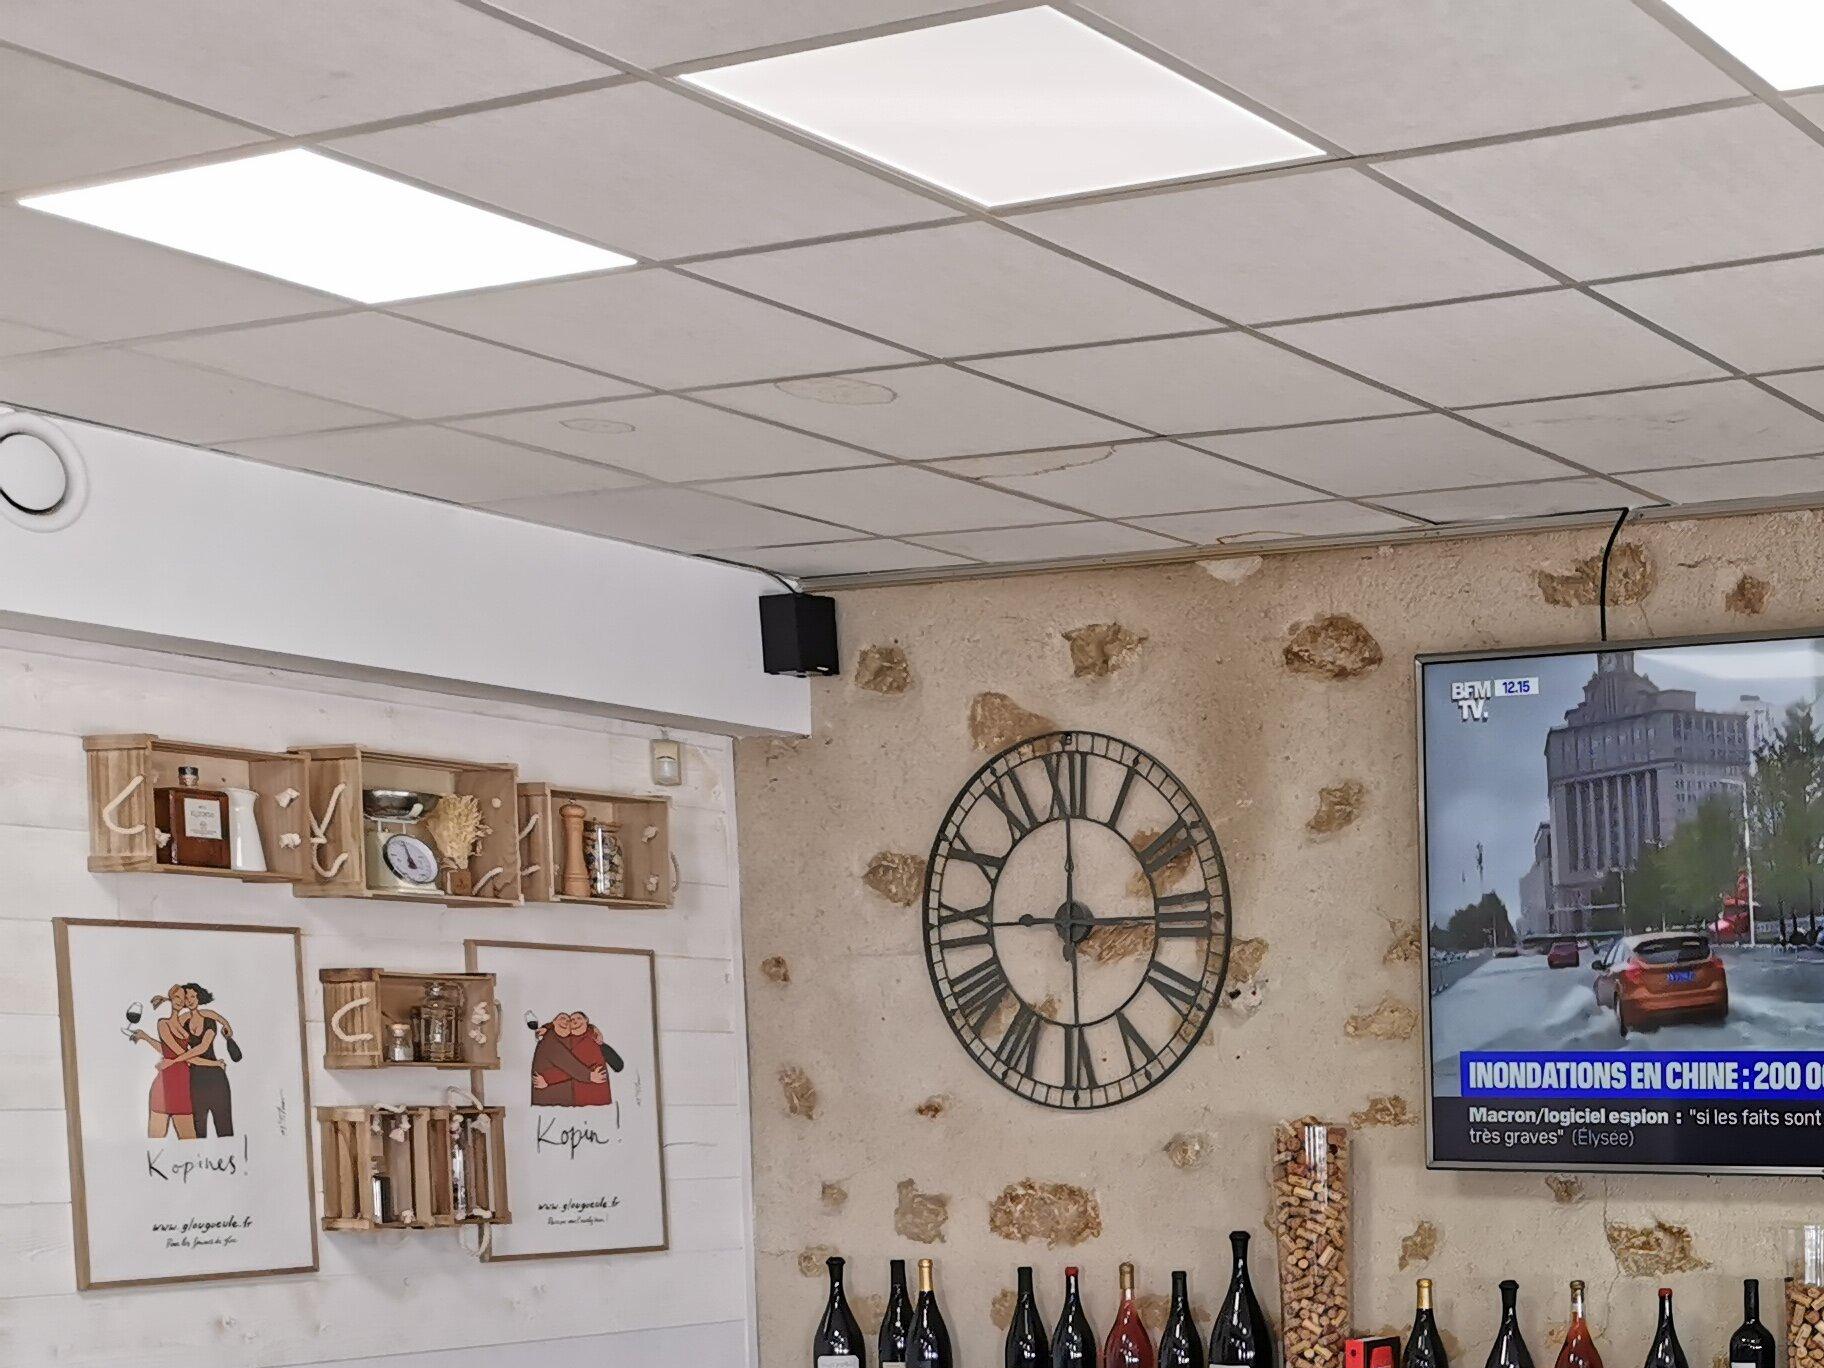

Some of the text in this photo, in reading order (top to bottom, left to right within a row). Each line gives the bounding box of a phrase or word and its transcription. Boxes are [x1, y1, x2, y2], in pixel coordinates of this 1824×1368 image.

[1451, 680, 1492, 701] BFM
[1468, 1061, 1627, 1090] INONDATIONS
[1630, 1061, 1662, 1090] EN
[1665, 1061, 1738, 1090] CHINE
[1753, 1061, 1801, 1090] 200
[1469, 1106, 1606, 1127] Macron/logiciel
[1608, 1108, 1669, 1128] espion
[1714, 1108, 1738, 1126] les
[1742, 1108, 1780, 1126] faits
[1784, 1109, 1822, 1127] sont
[1469, 1126, 1635, 1148] très graves" (Élysée)
